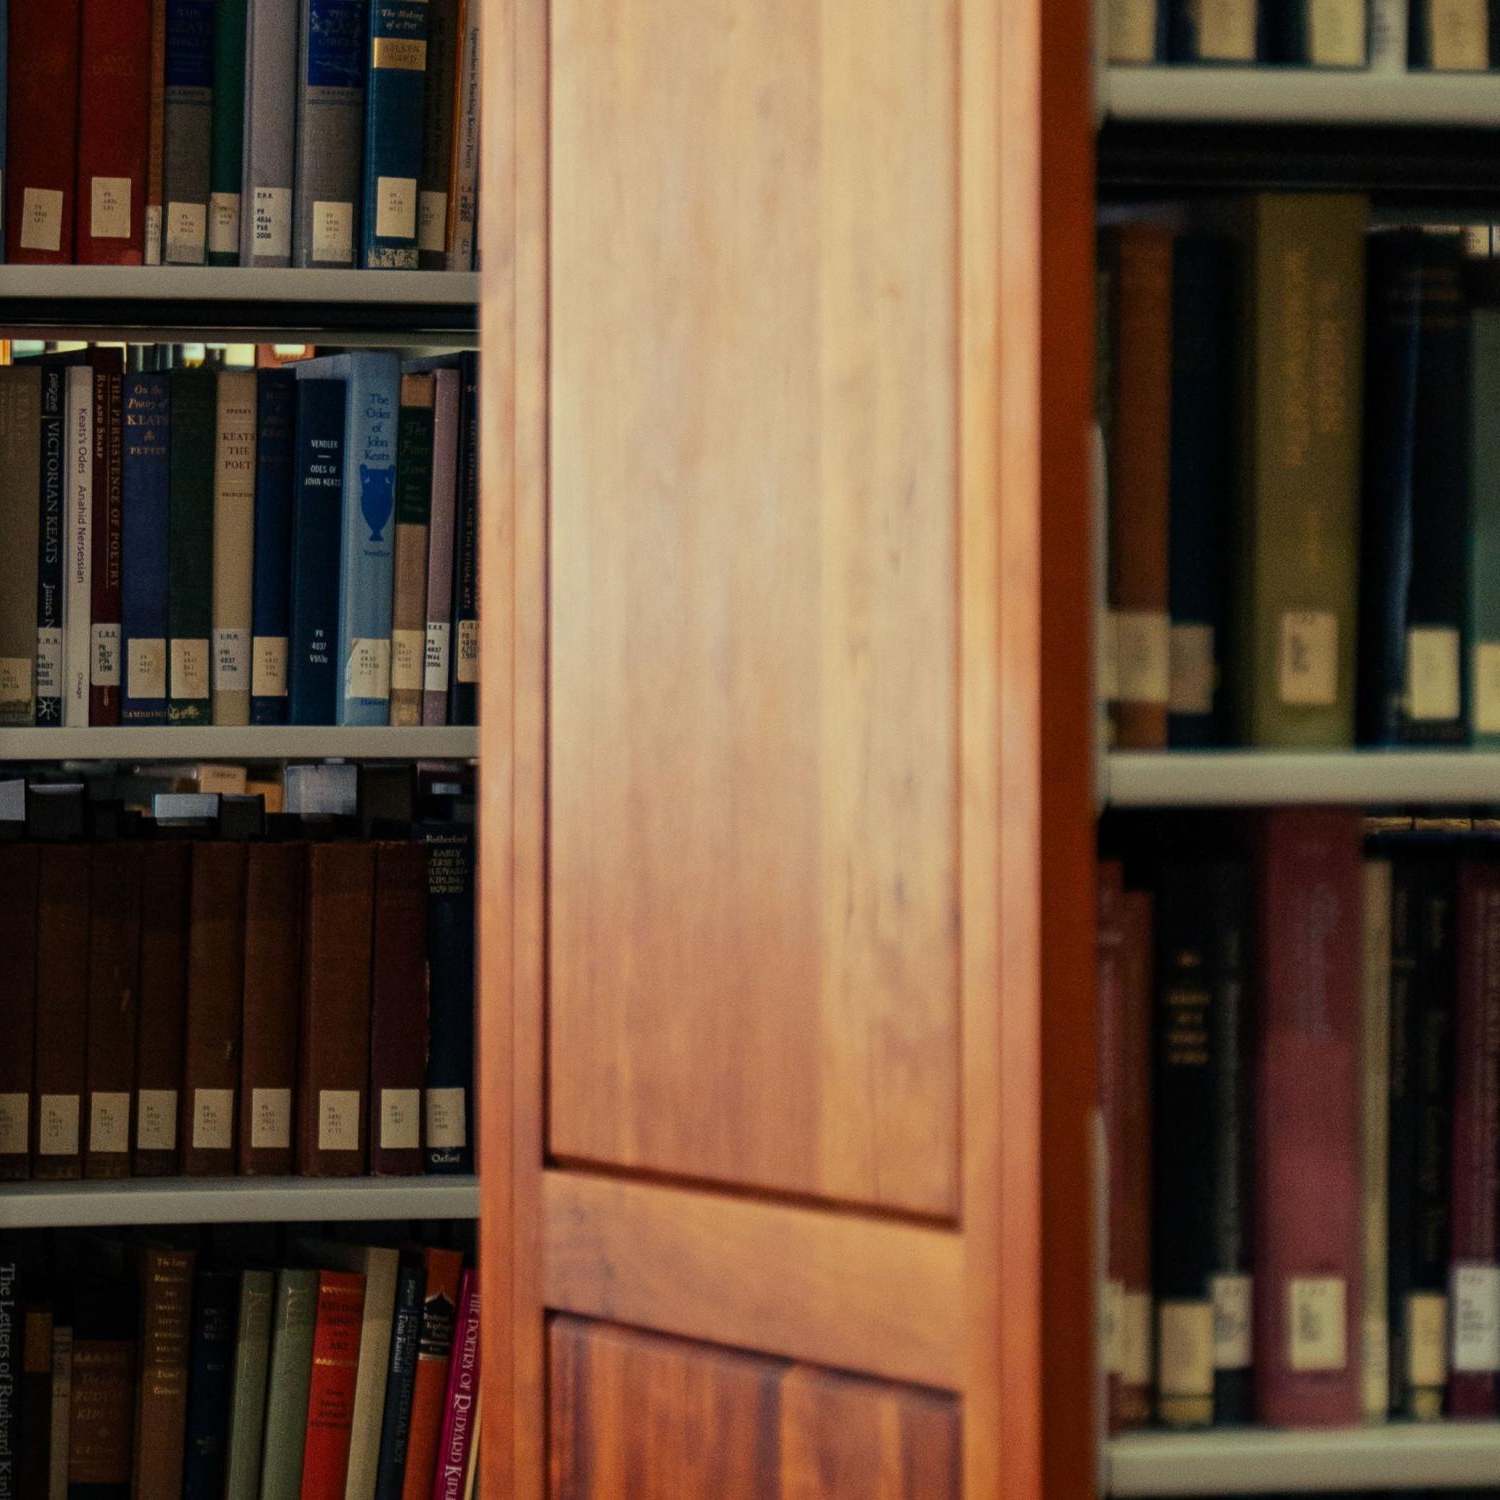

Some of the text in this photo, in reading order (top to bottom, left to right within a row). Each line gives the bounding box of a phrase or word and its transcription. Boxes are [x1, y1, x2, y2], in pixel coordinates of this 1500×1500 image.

[134, 384, 148, 395] On
[370, 393, 388, 405] The
[366, 407, 390, 419] Odes
[125, 416, 168, 426] KEATS
[372, 423, 383, 433] of
[222, 432, 255, 441] KEATS
[368, 436, 388, 448] John
[311, 439, 338, 449] VENDLER
[227, 447, 250, 456] THE
[365, 450, 390, 461] Keats
[225, 461, 252, 470] POET
[310, 464, 337, 474] ODES OF
[109, 375, 121, 587] THE PERSISTENCE OF POETRY
[304, 477, 341, 487] JOHN KEATS
[45, 421, 60, 564] VICTORIAN KEATS
[75, 408, 88, 584] Keats's Odes Anahid Nersessian
[43, 583, 56, 616] James
[312, 642, 327, 650] 4837
[431, 1153, 460, 1163] Oxford
[0, 1263, 16, 1296] The
[0, 1300, 15, 1358] Letters
[393, 1315, 408, 1373] Dan Randall
[462, 1319, 478, 1372] POETRY
[0, 1362, 14, 1381] of
[460, 1373, 472, 1391] OF
[451, 1393, 471, 1463] RUDYARD
